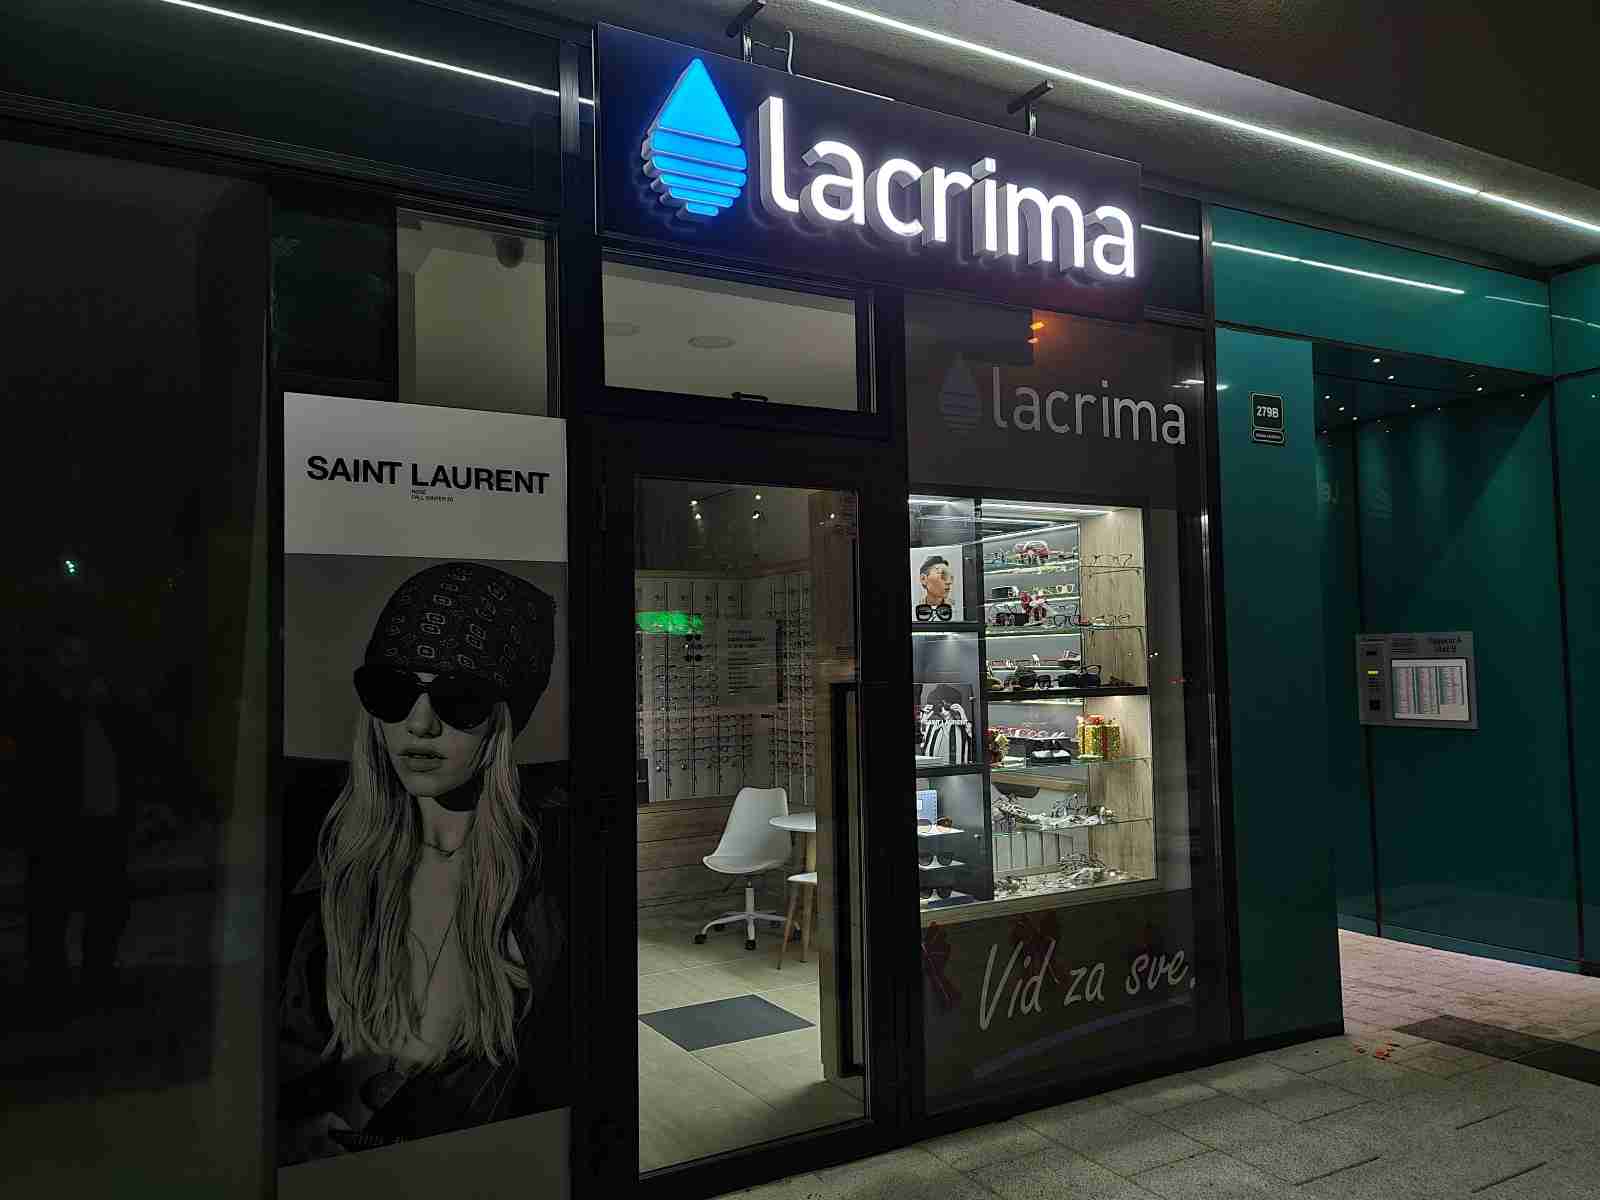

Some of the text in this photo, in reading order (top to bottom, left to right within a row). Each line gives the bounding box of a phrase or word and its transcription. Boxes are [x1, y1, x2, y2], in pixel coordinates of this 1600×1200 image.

[760, 95, 1137, 278] lacrima
[991, 366, 1186, 446] lacrima
[1256, 405, 1279, 418] 279B
[306, 455, 550, 494] SAINT LAURENT
[978, 939, 1196, 1031] Vid za sve.
